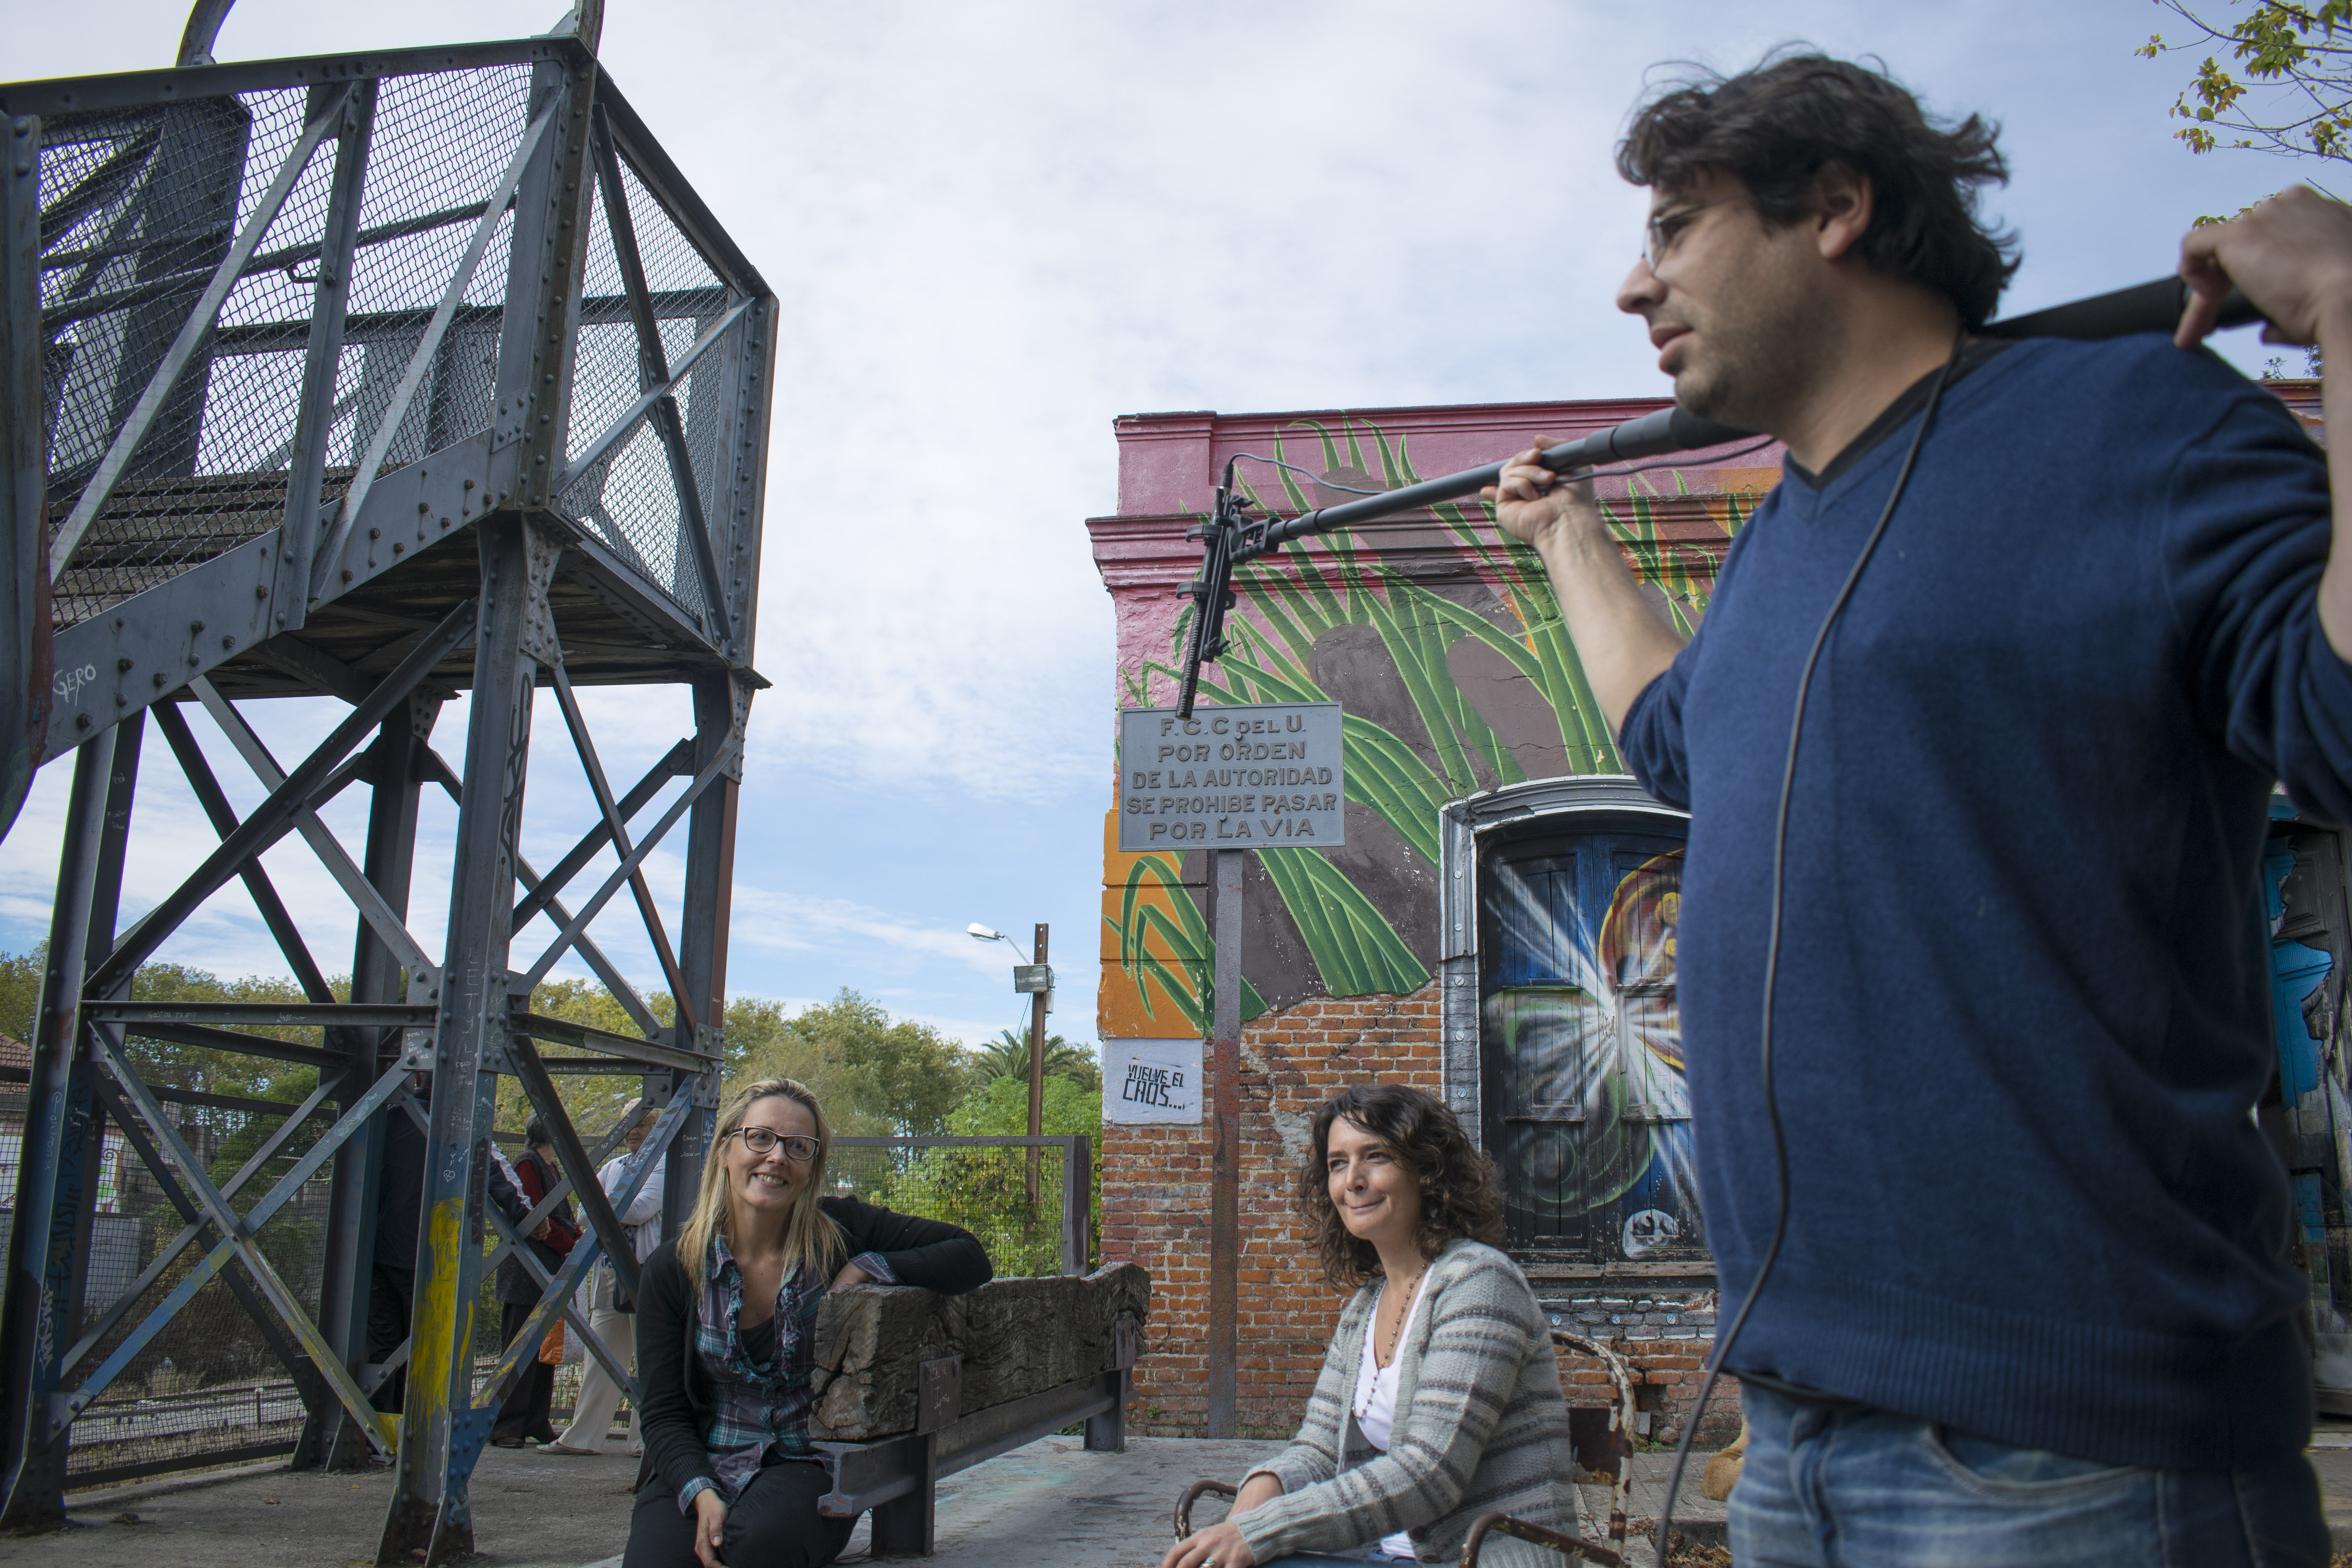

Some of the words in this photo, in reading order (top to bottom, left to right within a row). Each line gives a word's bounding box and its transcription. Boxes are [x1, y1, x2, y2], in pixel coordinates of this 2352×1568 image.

[1158, 744, 1210, 762] POR
[1219, 742, 1305, 761] ORDEN
[1133, 771, 1160, 789] DE
[1169, 769, 1197, 788] LA
[1202, 767, 1332, 787] AUTORIDAD
[1126, 797, 1155, 814] SE
[1159, 794, 1255, 813] PROHIBE
[1262, 792, 1337, 812] PASAR
[1149, 821, 1206, 840] POR
[1217, 819, 1252, 838] LA
[1260, 818, 1315, 837] VIA
[1128, 1064, 1169, 1084] VUELVE
[1172, 1072, 1184, 1087] EL
